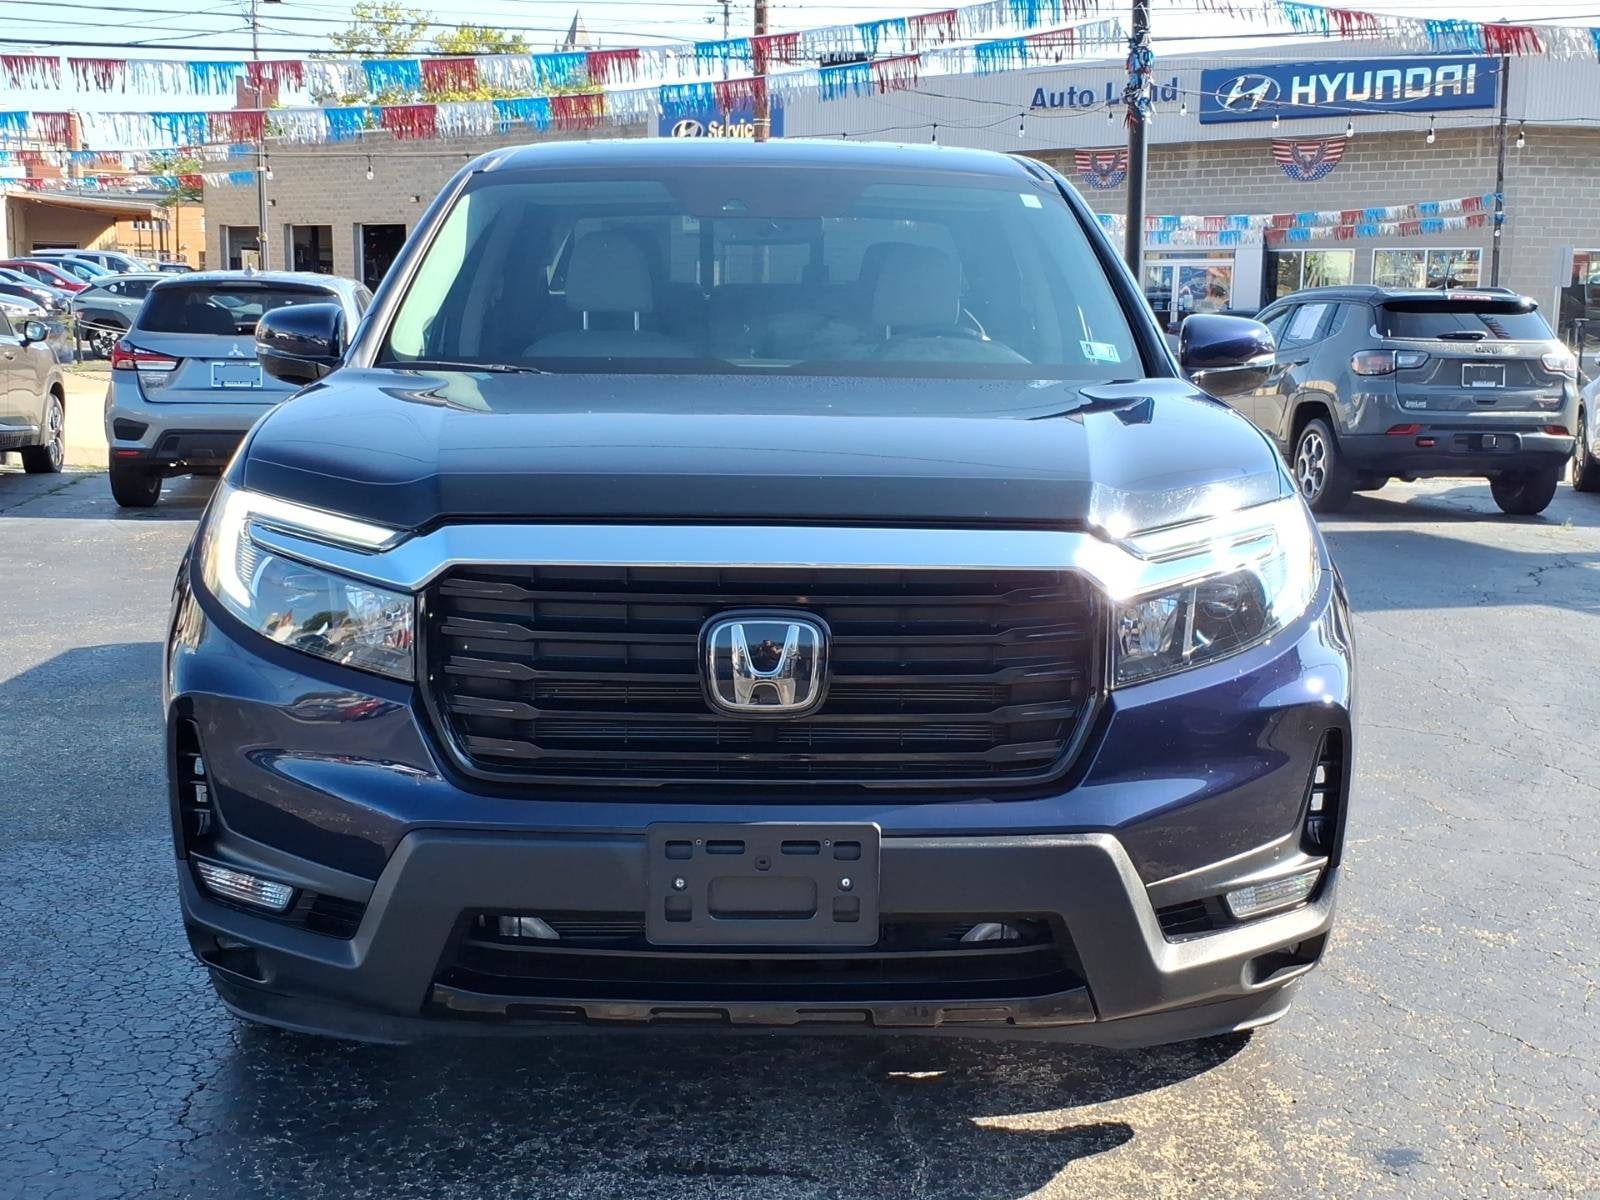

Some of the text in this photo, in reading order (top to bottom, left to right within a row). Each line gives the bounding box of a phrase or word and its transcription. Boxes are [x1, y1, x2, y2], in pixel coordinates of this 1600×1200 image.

[1030, 77, 1177, 110] Auto Ld
[1291, 63, 1476, 105] HYUNDAI
[708, 118, 755, 138] Servic
